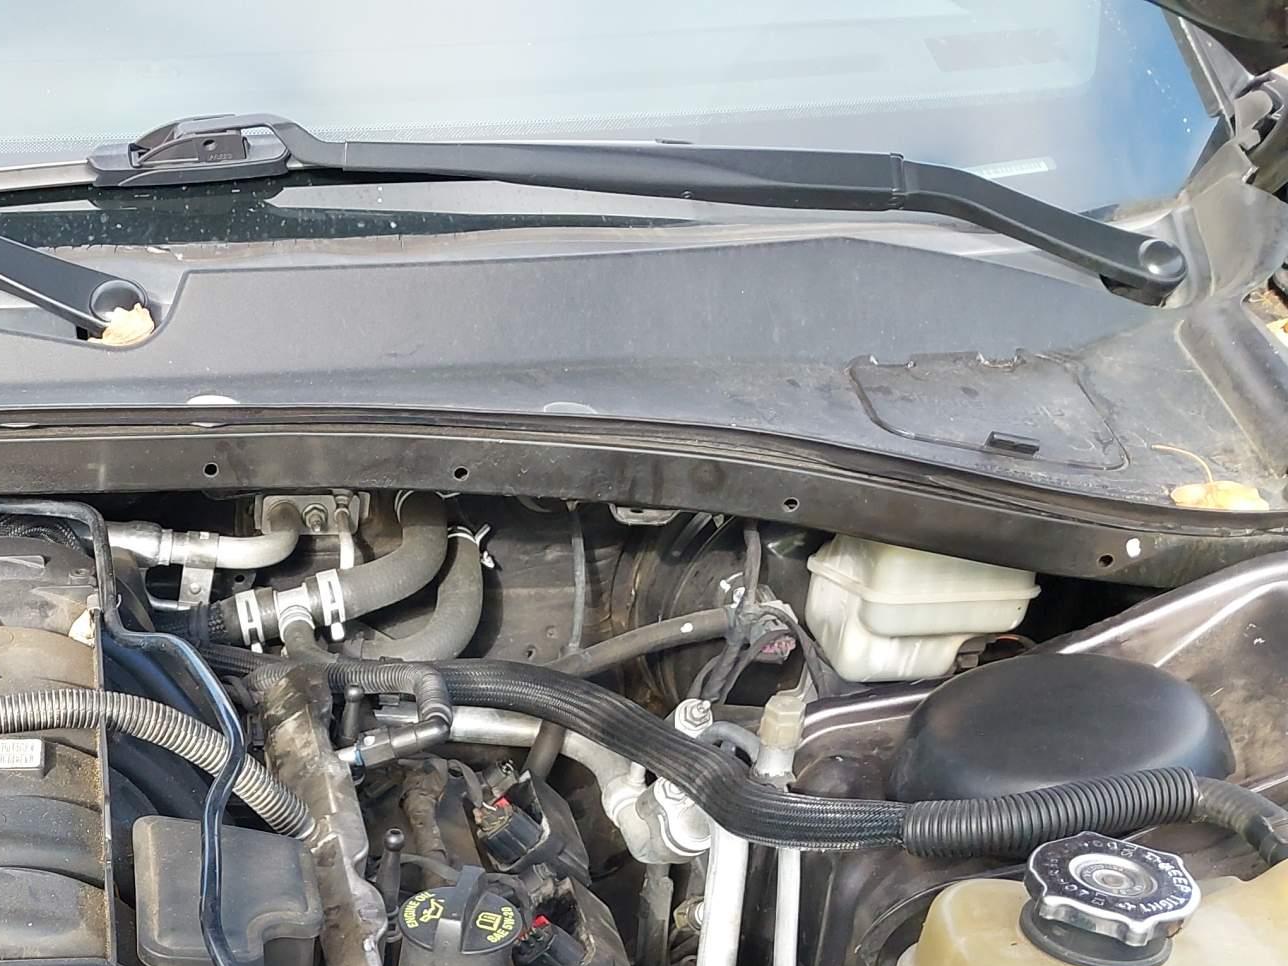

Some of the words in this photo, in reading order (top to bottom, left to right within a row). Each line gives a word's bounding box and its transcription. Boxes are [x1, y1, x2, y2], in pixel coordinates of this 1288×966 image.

[403, 899, 420, 929] ENGINE
[415, 890, 436, 902] OIL
[486, 927, 509, 944] SAE
[501, 906, 516, 931] 5W-20
